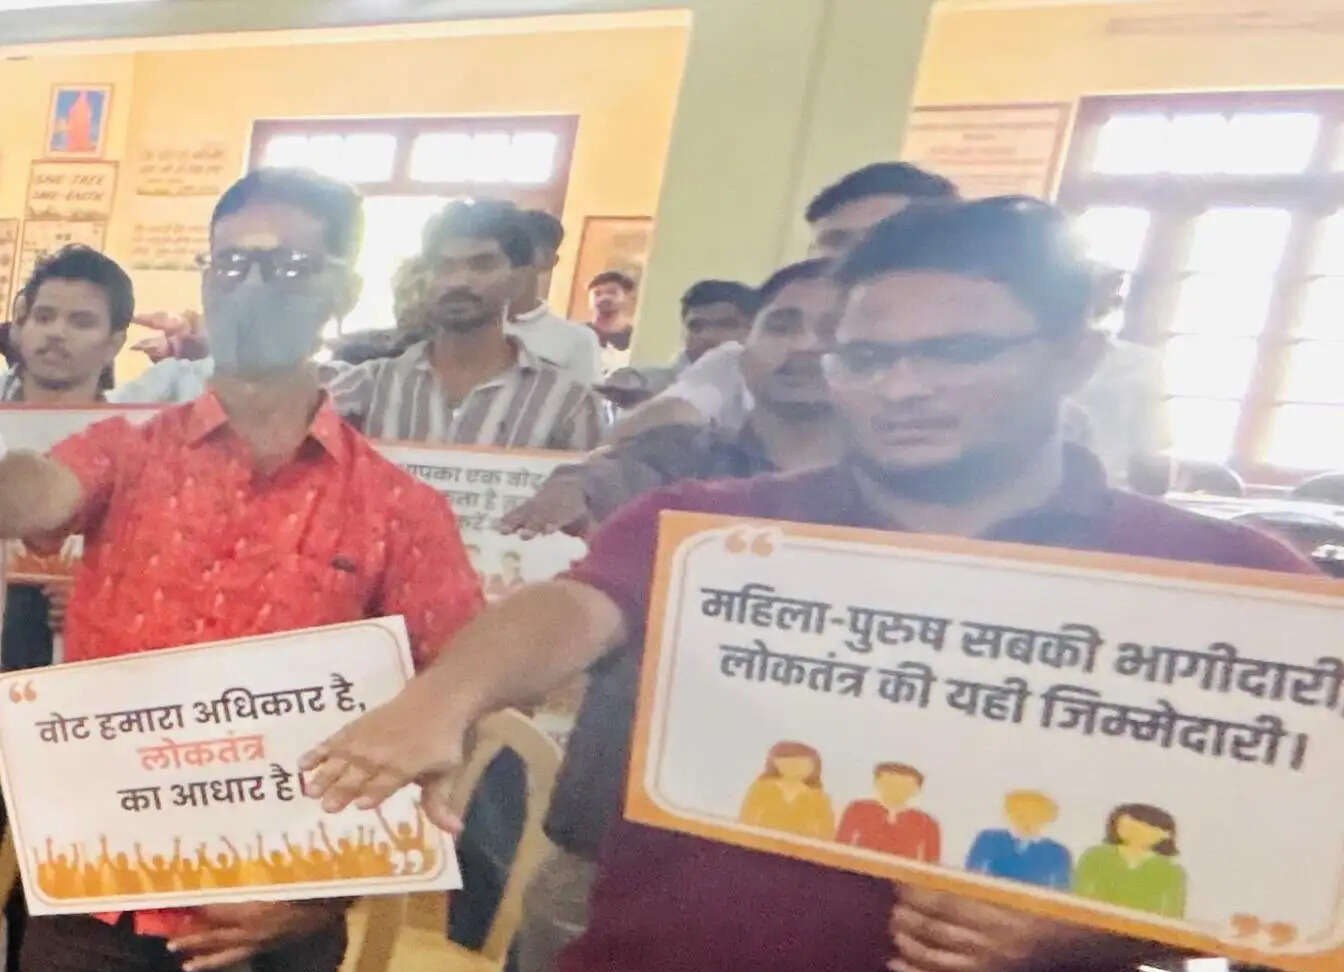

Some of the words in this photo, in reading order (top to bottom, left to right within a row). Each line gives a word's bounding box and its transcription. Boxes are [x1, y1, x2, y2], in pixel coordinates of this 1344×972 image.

[699, 582, 949, 654] महिला-पुरुष
[960, 623, 1103, 676] सबकी
[1114, 639, 1344, 717] भागीदारी
[719, 643, 866, 698] लोकतंत्र
[878, 661, 931, 710] की
[946, 677, 1030, 724] यही
[34, 712, 92, 745] वोट
[95, 703, 186, 742] हमारा
[193, 684, 327, 727] अधिकार
[137, 730, 266, 772] लोकतंत्र
[116, 781, 162, 814] का
[170, 773, 266, 808] आधार
